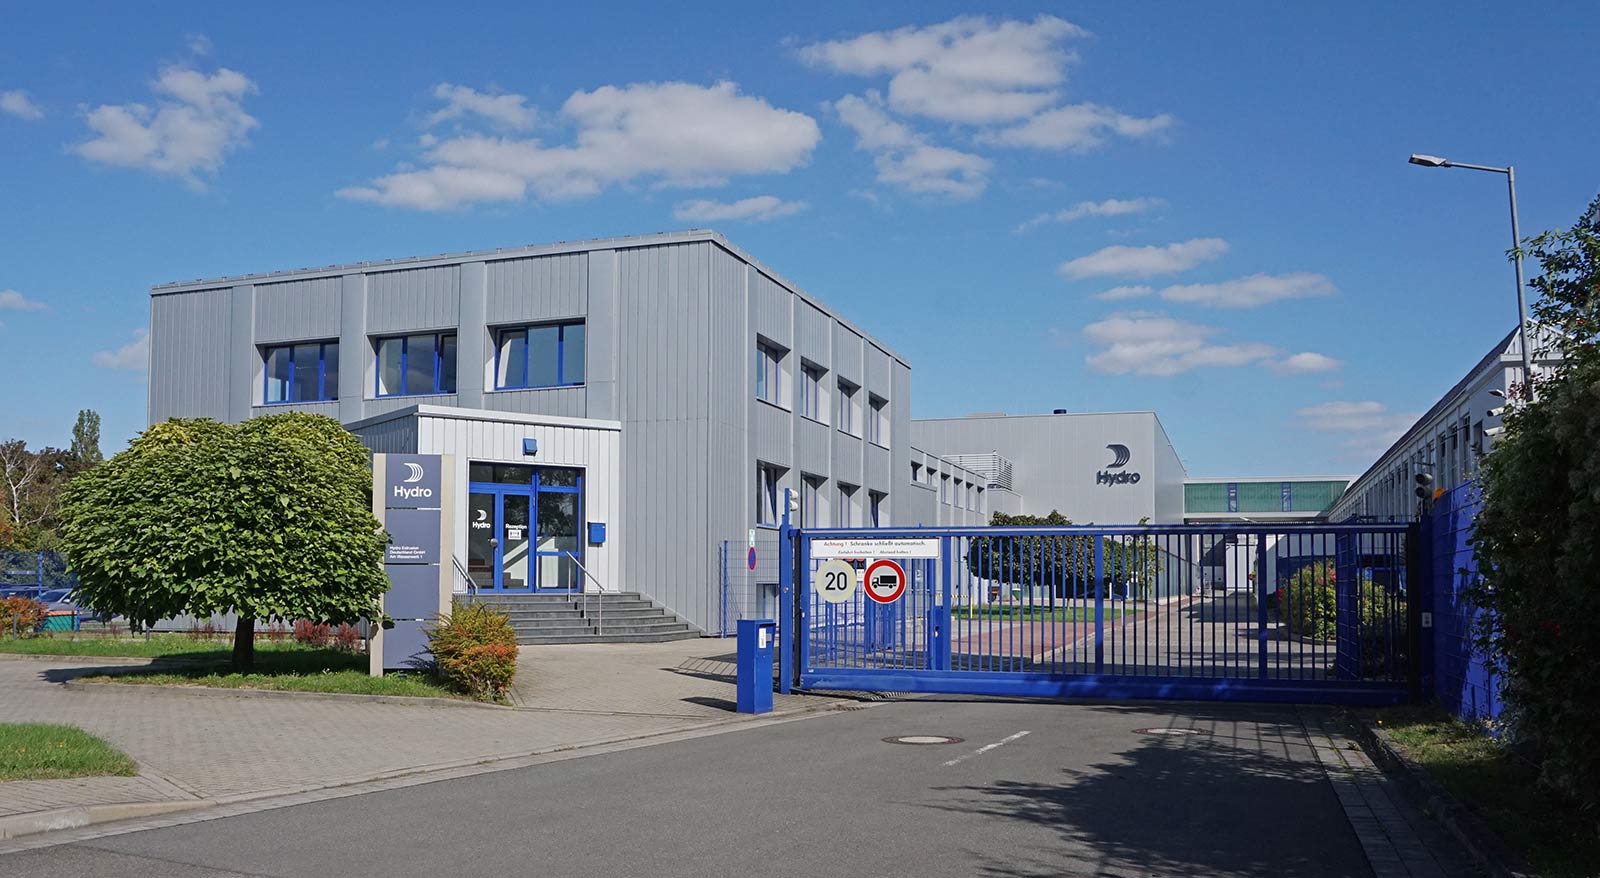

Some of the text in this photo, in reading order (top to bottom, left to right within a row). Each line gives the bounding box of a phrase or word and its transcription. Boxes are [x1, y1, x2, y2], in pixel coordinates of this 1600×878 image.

[1096, 470, 1141, 488] Hydro
[394, 485, 432, 499] Hydro
[472, 521, 491, 530] Hydro
[825, 571, 848, 591] 20
